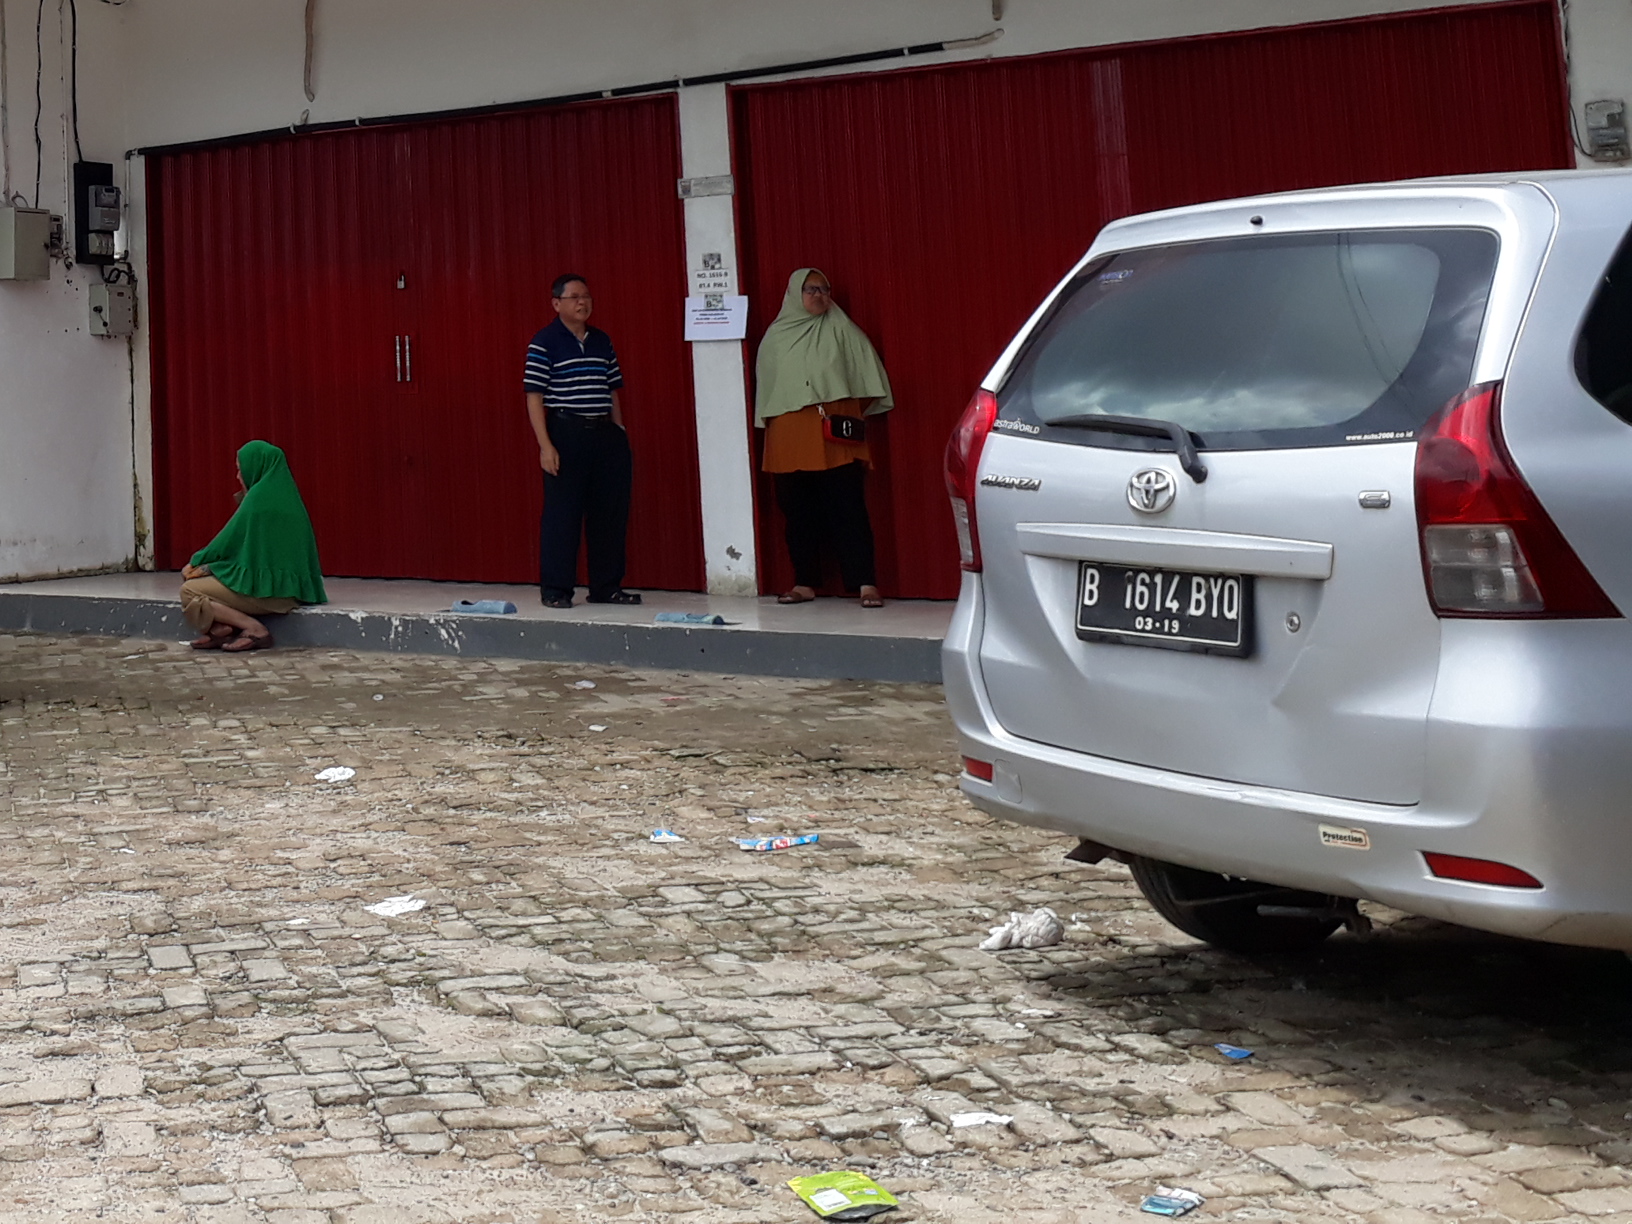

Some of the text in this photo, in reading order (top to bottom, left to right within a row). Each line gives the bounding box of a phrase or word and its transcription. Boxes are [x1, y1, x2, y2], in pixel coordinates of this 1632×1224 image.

[981, 474, 1042, 491] AVANZA
[1083, 567, 1240, 620] B 1614 BYQ
